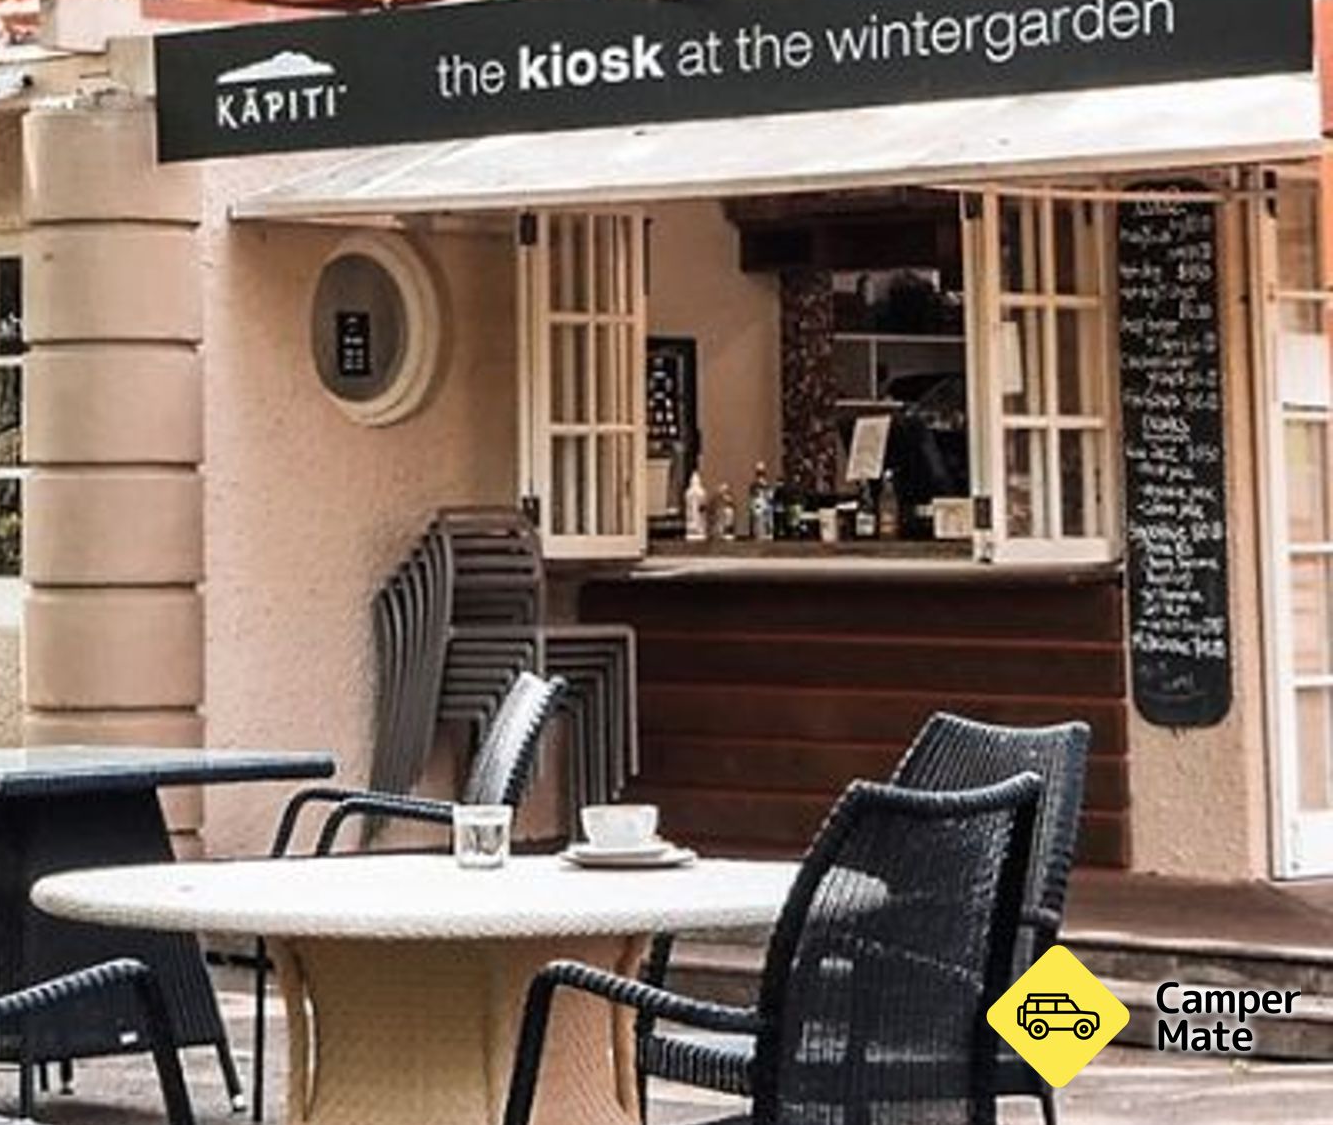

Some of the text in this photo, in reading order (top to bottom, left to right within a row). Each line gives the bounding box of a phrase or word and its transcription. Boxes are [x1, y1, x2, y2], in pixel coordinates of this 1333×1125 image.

[437, 53, 506, 98] the
[518, 34, 666, 91] kiosk
[677, 30, 723, 77] at
[735, 24, 814, 72] the
